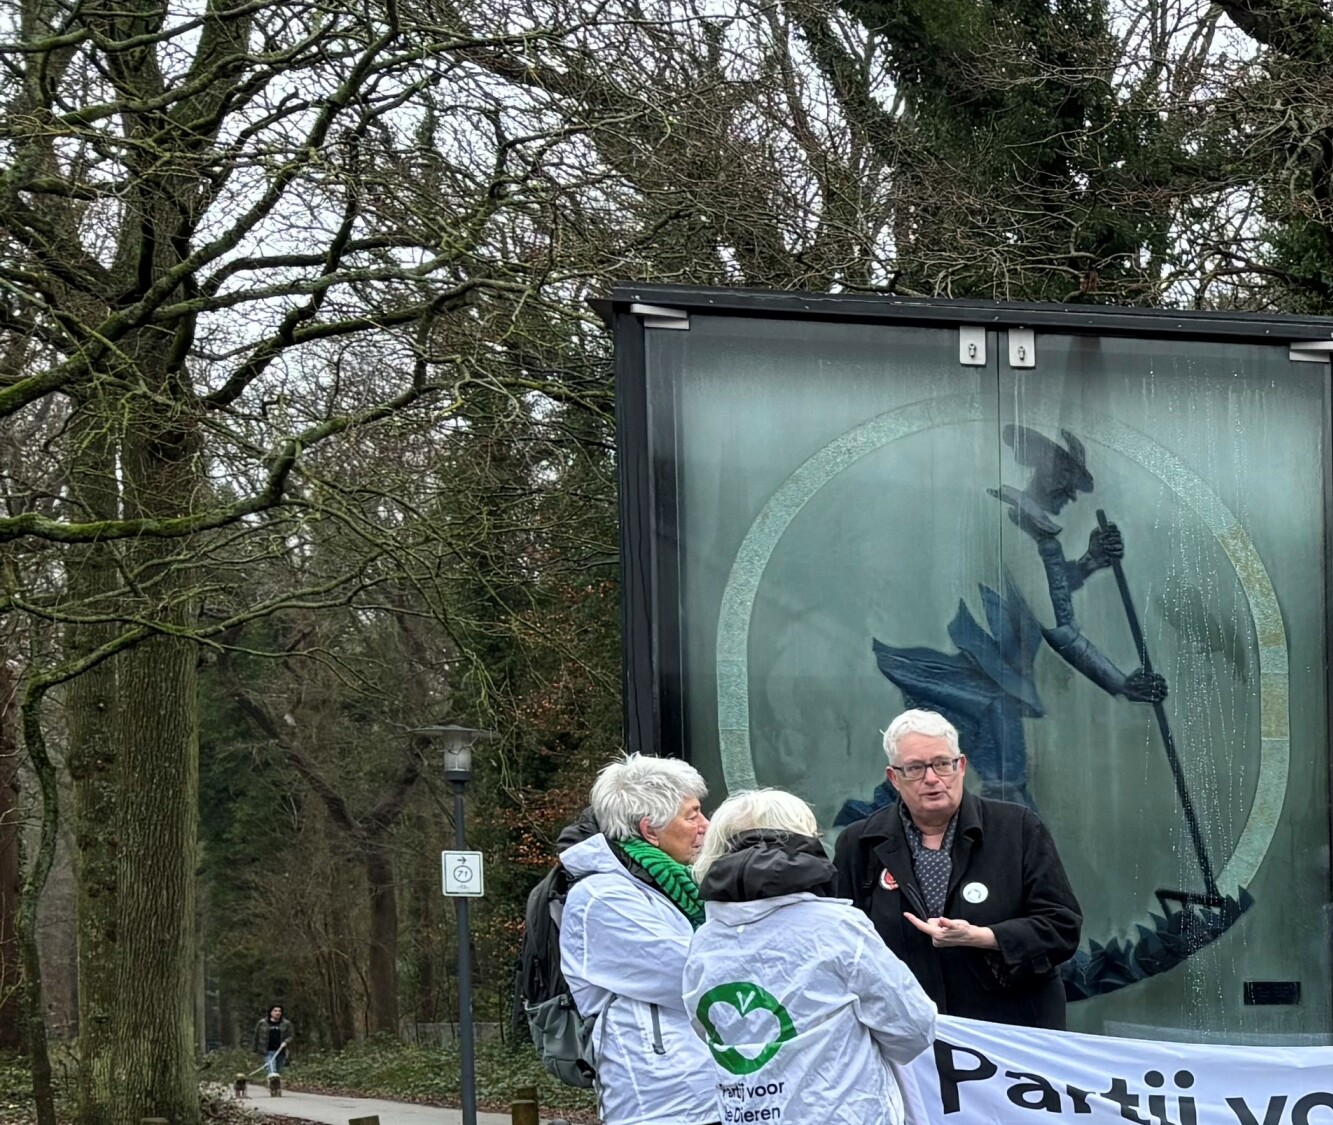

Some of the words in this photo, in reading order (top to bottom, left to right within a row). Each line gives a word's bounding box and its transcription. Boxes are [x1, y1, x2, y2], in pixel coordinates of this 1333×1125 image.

[457, 870, 468, 878] 71
[746, 1082, 785, 1099] voor
[733, 1106, 781, 1123] Dieren
